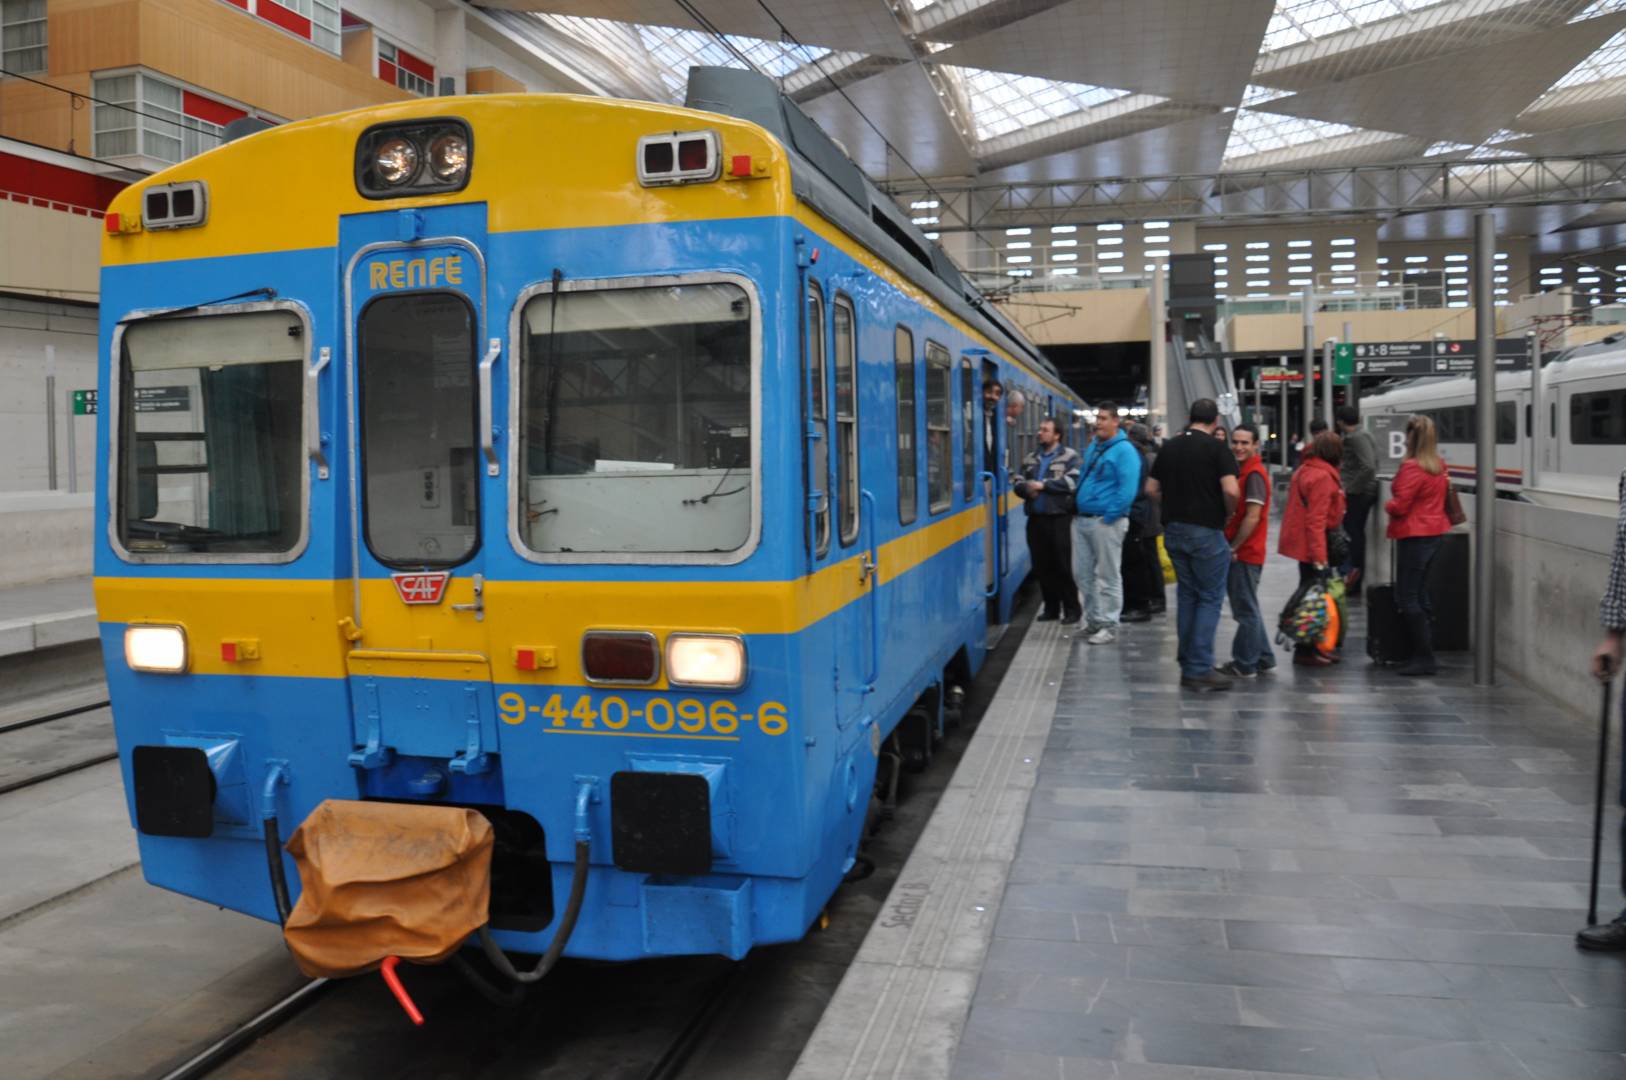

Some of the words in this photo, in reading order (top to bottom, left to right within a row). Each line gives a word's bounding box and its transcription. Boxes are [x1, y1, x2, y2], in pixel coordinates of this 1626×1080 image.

[369, 256, 463, 289] RENFE
[1389, 431, 1407, 458] B
[400, 576, 445, 600] CAF
[498, 692, 788, 735] 9-440-096-6
